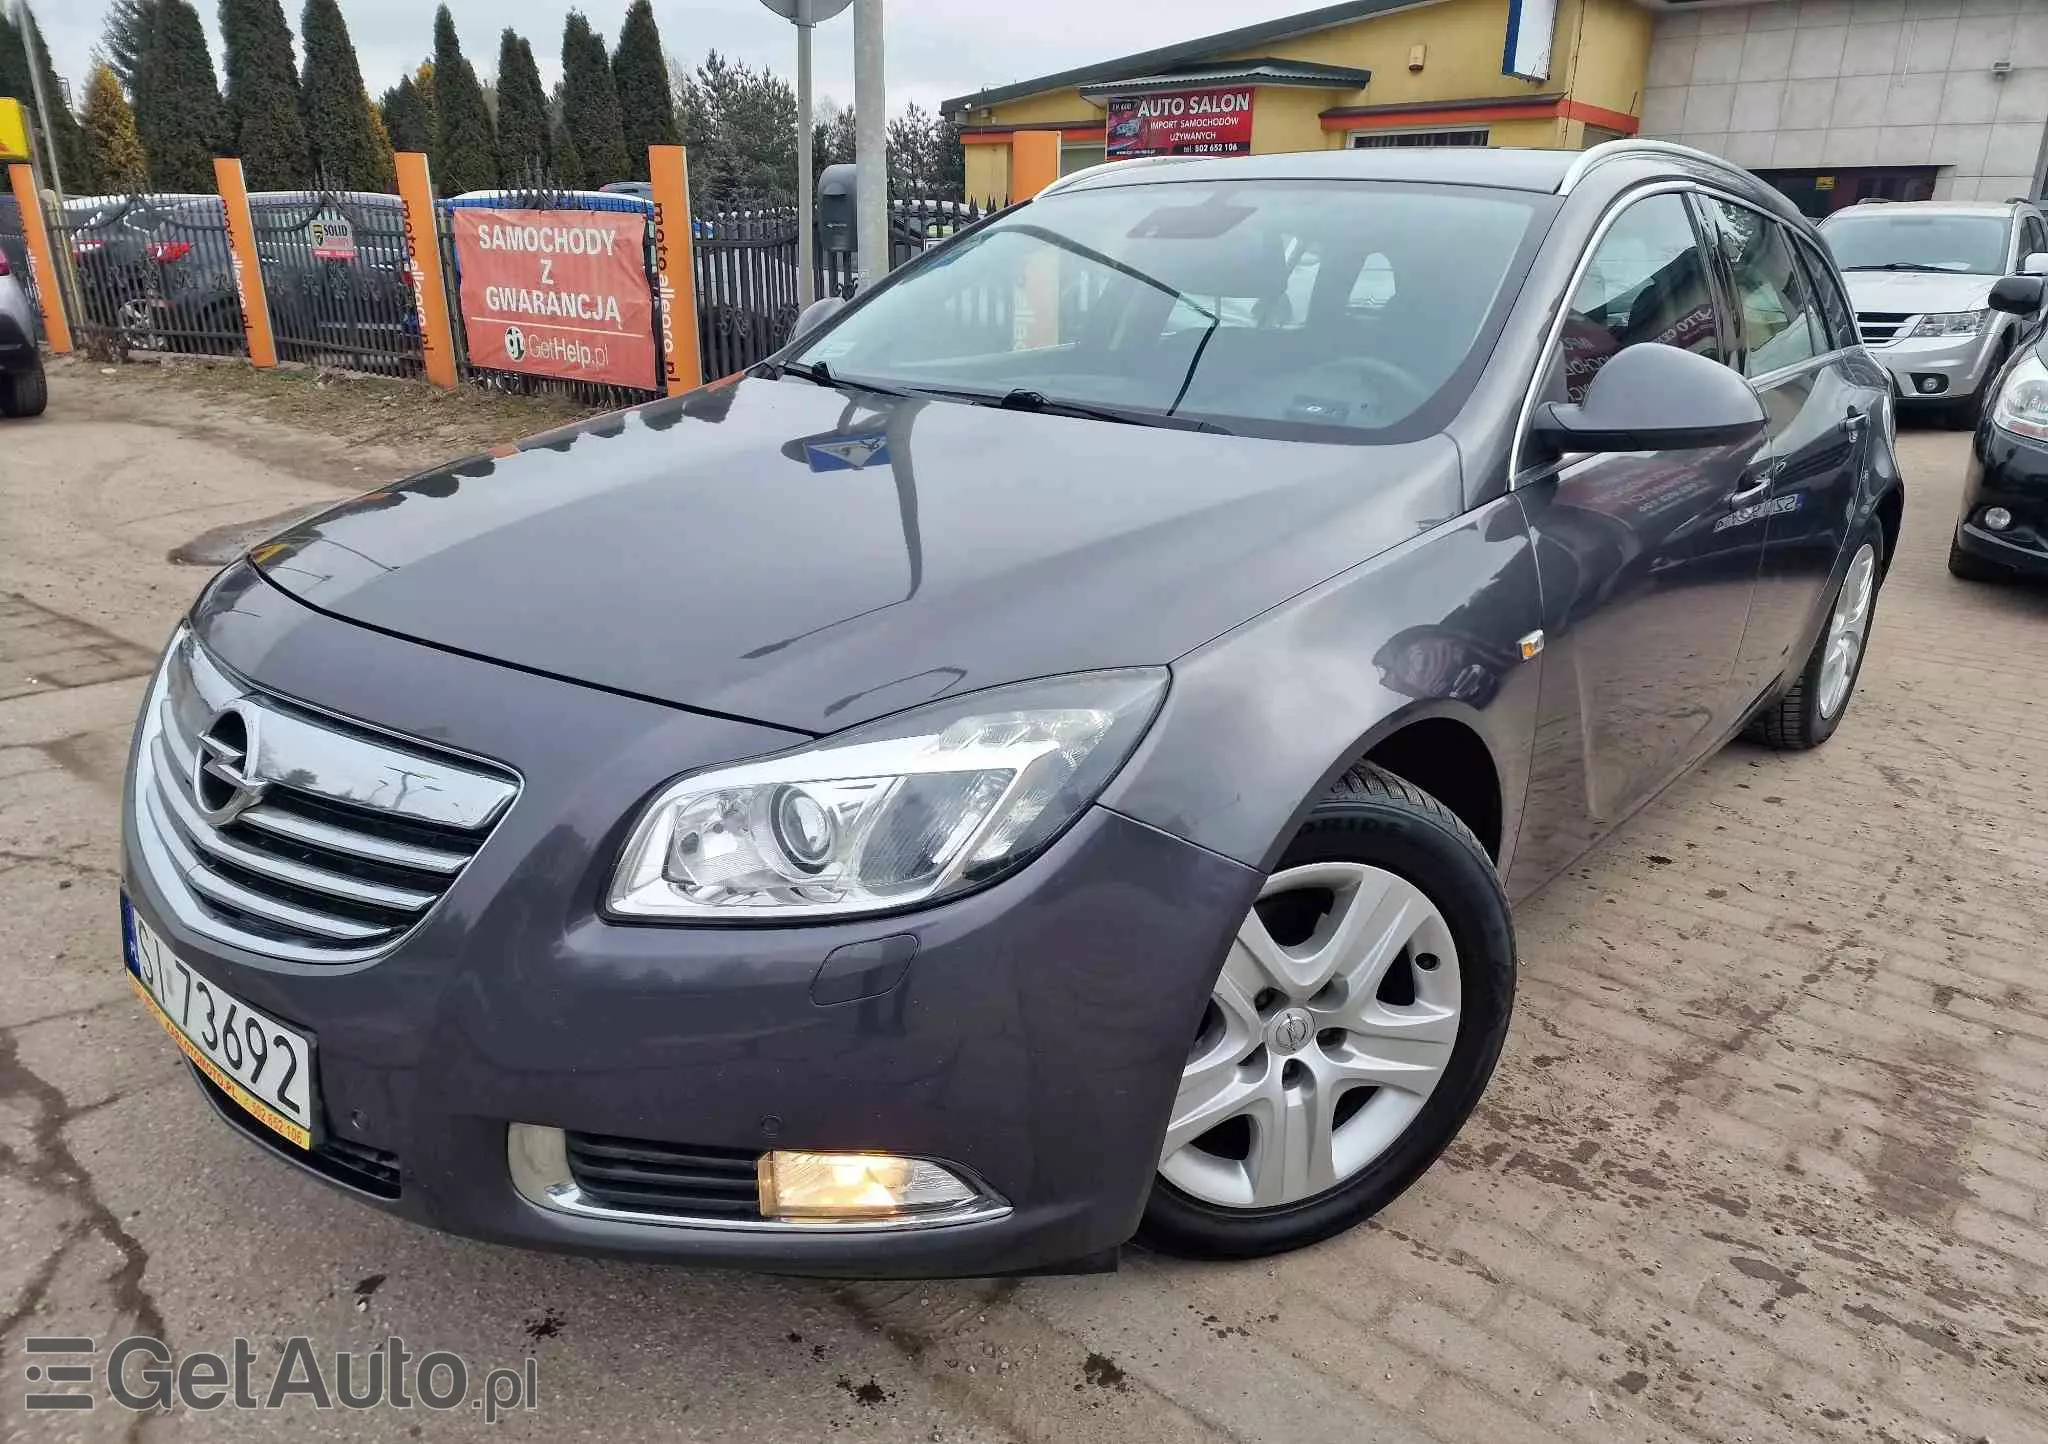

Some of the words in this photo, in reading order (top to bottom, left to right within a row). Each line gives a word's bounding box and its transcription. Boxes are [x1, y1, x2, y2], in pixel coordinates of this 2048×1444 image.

[1138, 97, 1185, 117] AUTO
[1189, 92, 1250, 115] SALON
[1150, 119, 1177, 130] IMPORT
[323, 224, 348, 237] SOLID
[478, 223, 616, 256] SAMOCHODY
[539, 258, 555, 285] Z
[485, 285, 623, 330] GWARANCJĄ
[527, 333, 609, 371] GetHelp.pl
[175, 959, 300, 1115] 73692
